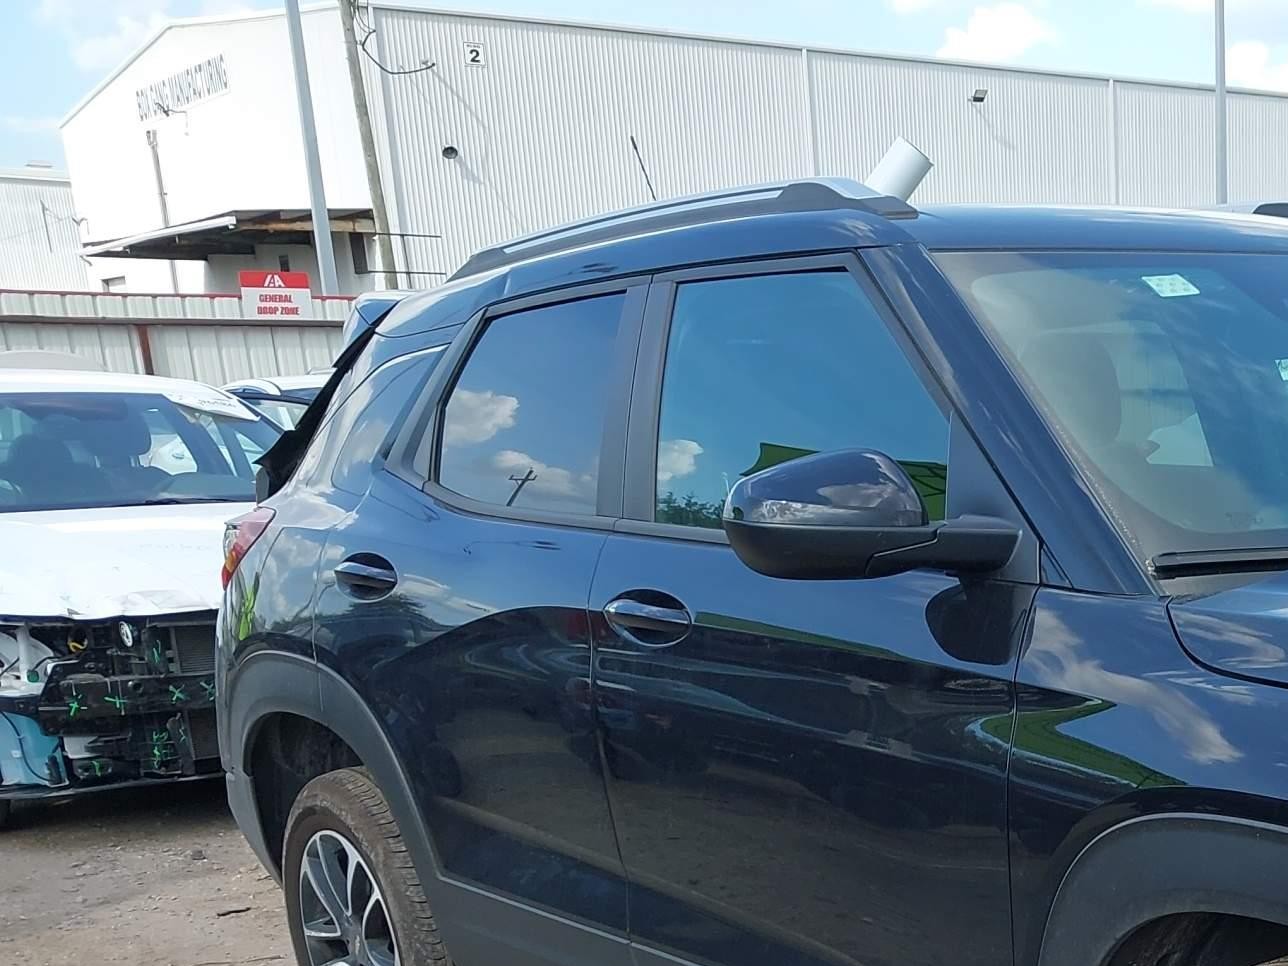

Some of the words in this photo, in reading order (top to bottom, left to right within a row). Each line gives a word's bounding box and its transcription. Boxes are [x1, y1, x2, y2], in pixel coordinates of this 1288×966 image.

[469, 49, 481, 63] 2
[167, 53, 228, 109] MANUFACTURING
[259, 294, 293, 303] GENERAL
[257, 306, 279, 315] DROP
[280, 306, 300, 316] ZONE
